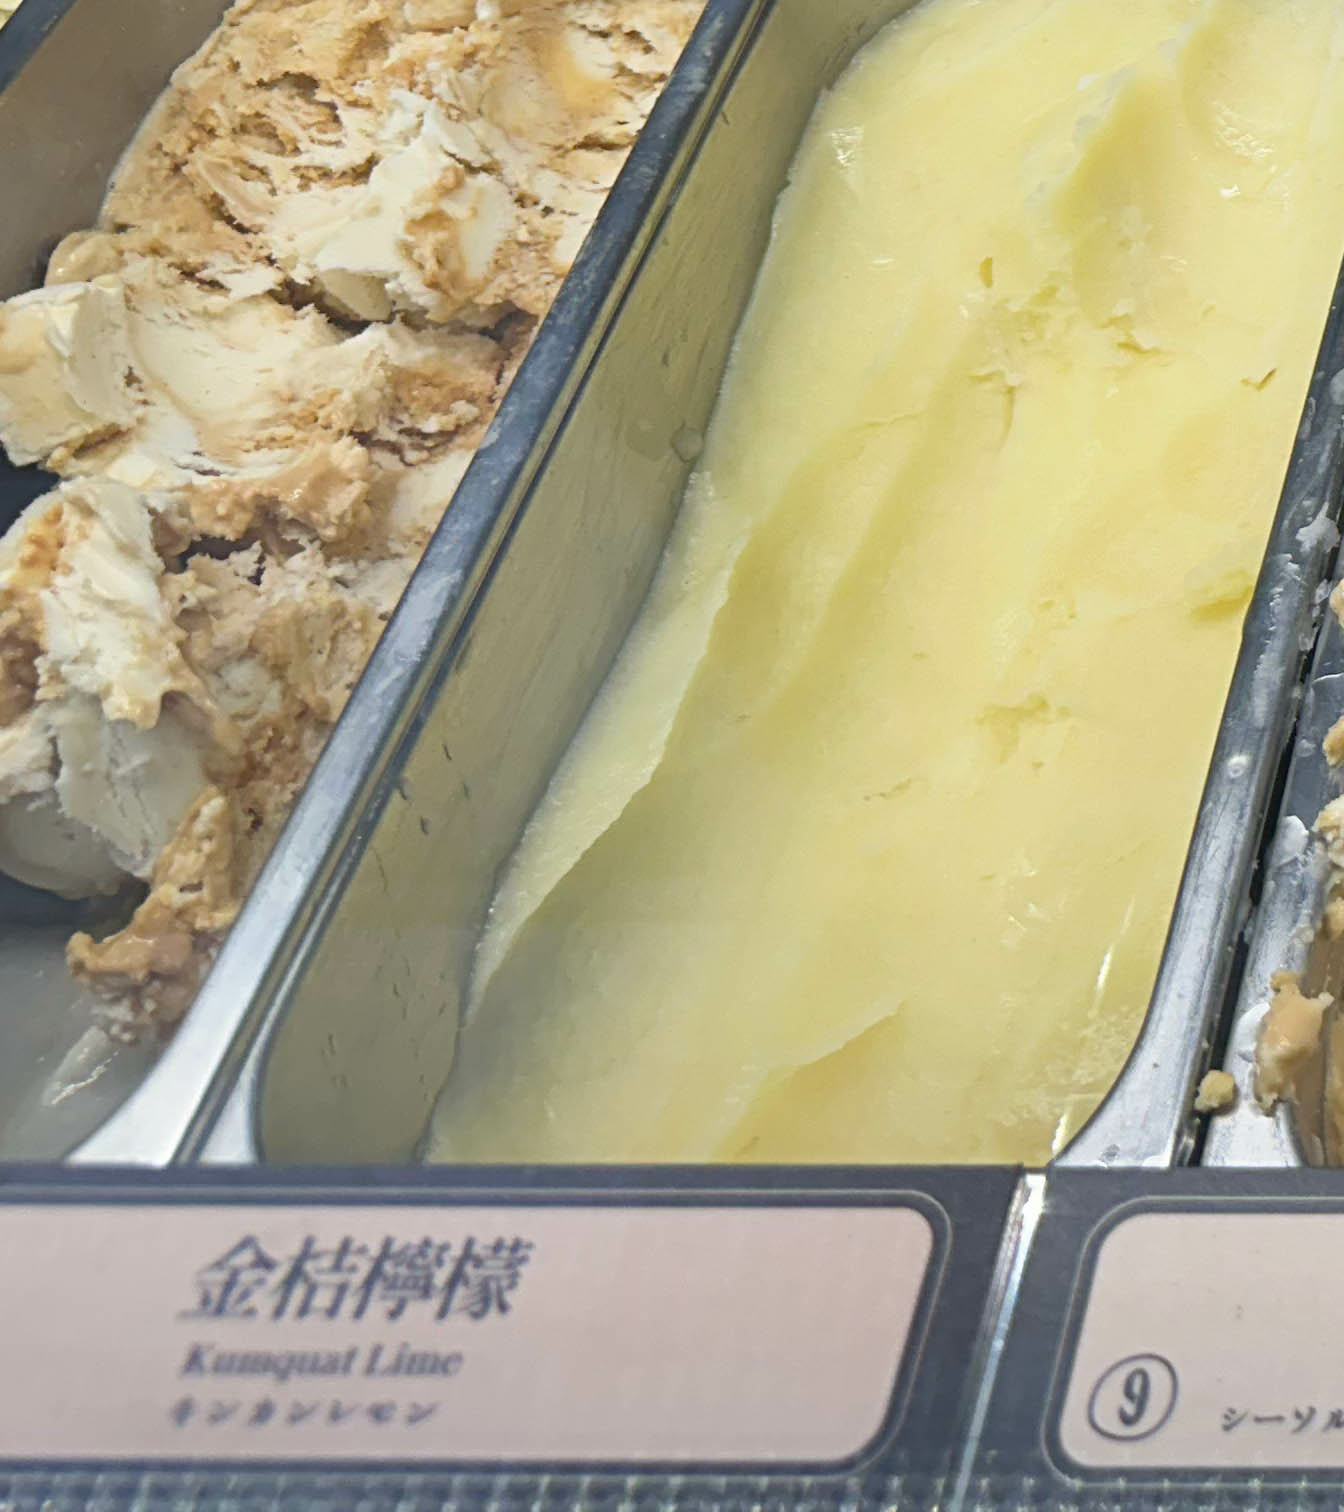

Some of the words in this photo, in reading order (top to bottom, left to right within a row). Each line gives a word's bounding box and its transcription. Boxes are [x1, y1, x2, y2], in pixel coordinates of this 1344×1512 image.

[176, 1235, 535, 1321] 金桔檸檬
[180, 1341, 358, 1384] Kumquat
[364, 1341, 464, 1377] Lime
